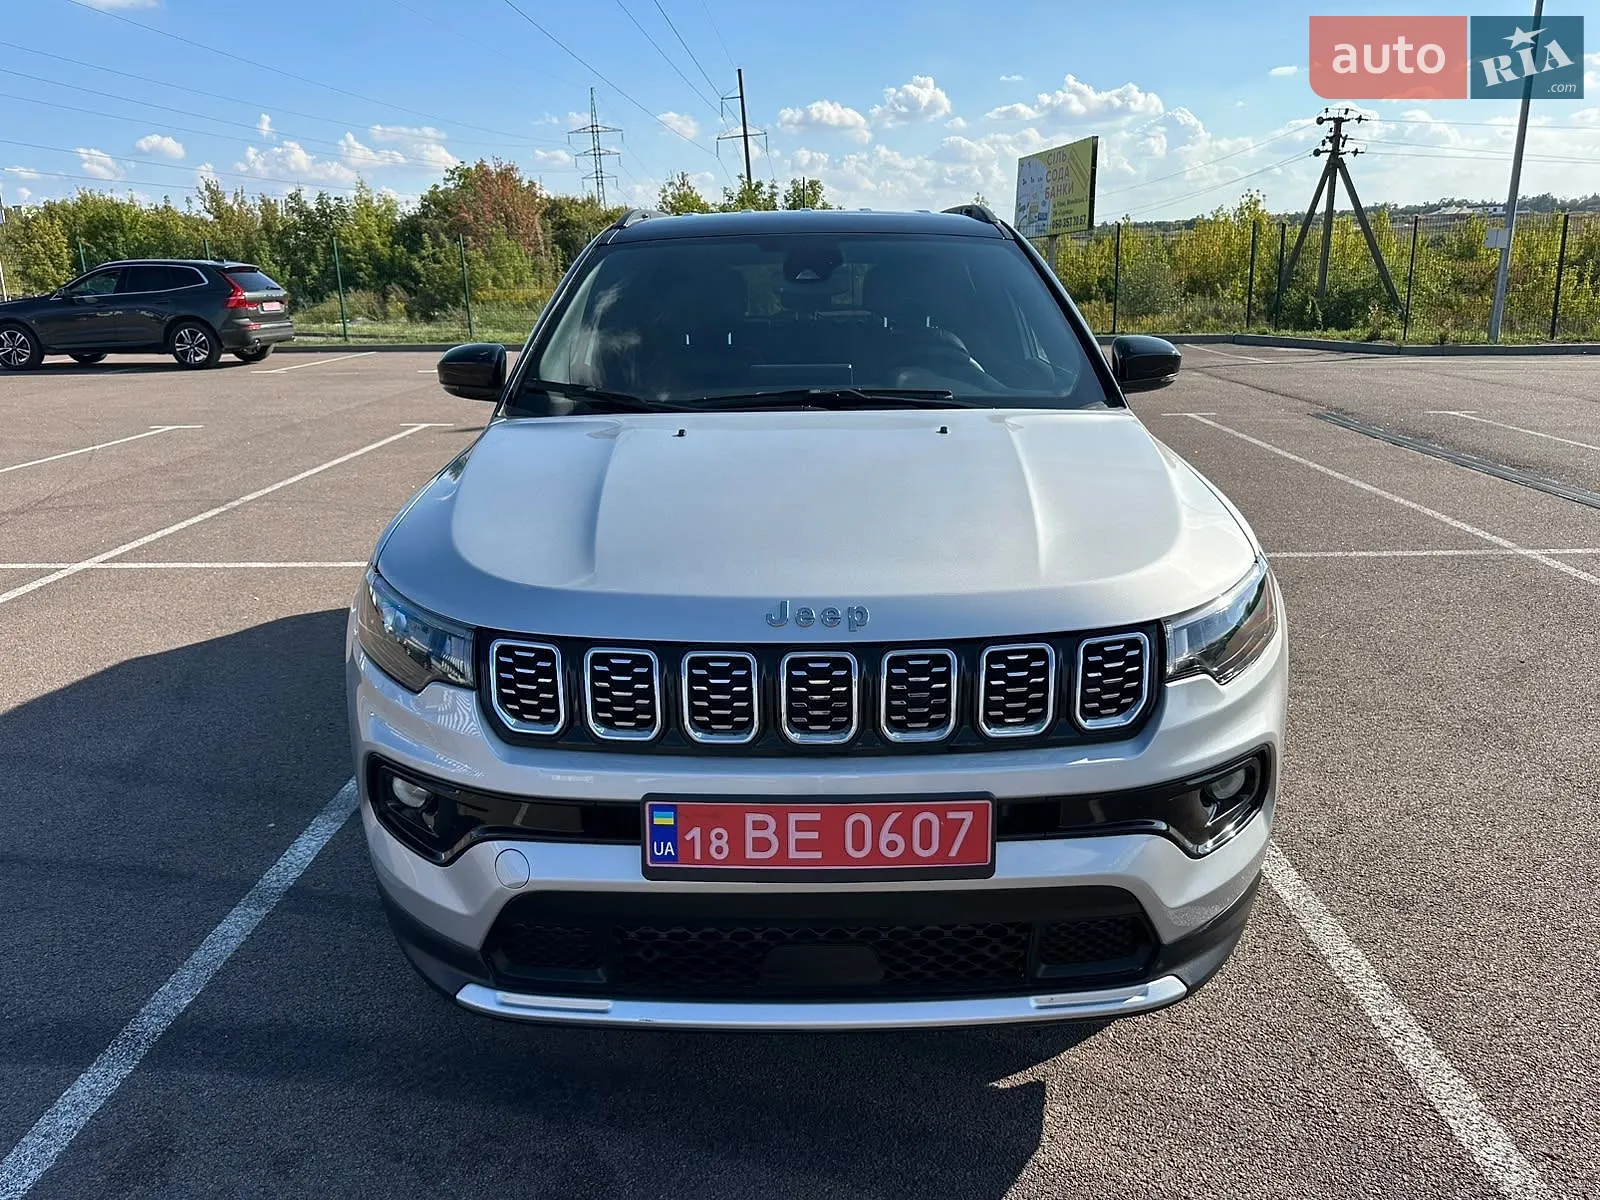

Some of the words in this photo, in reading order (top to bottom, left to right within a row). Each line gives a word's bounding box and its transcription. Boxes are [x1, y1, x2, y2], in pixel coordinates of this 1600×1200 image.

[1047, 150, 1067, 165] СІЛЬ
[1046, 166, 1070, 183] СОДА
[1045, 182, 1074, 200] БАНКИ
[765, 599, 870, 632] Jeep
[684, 827, 729, 861] 18
[744, 812, 823, 860] BE
[844, 811, 975, 860] 0607
[653, 841, 675, 856] UA
